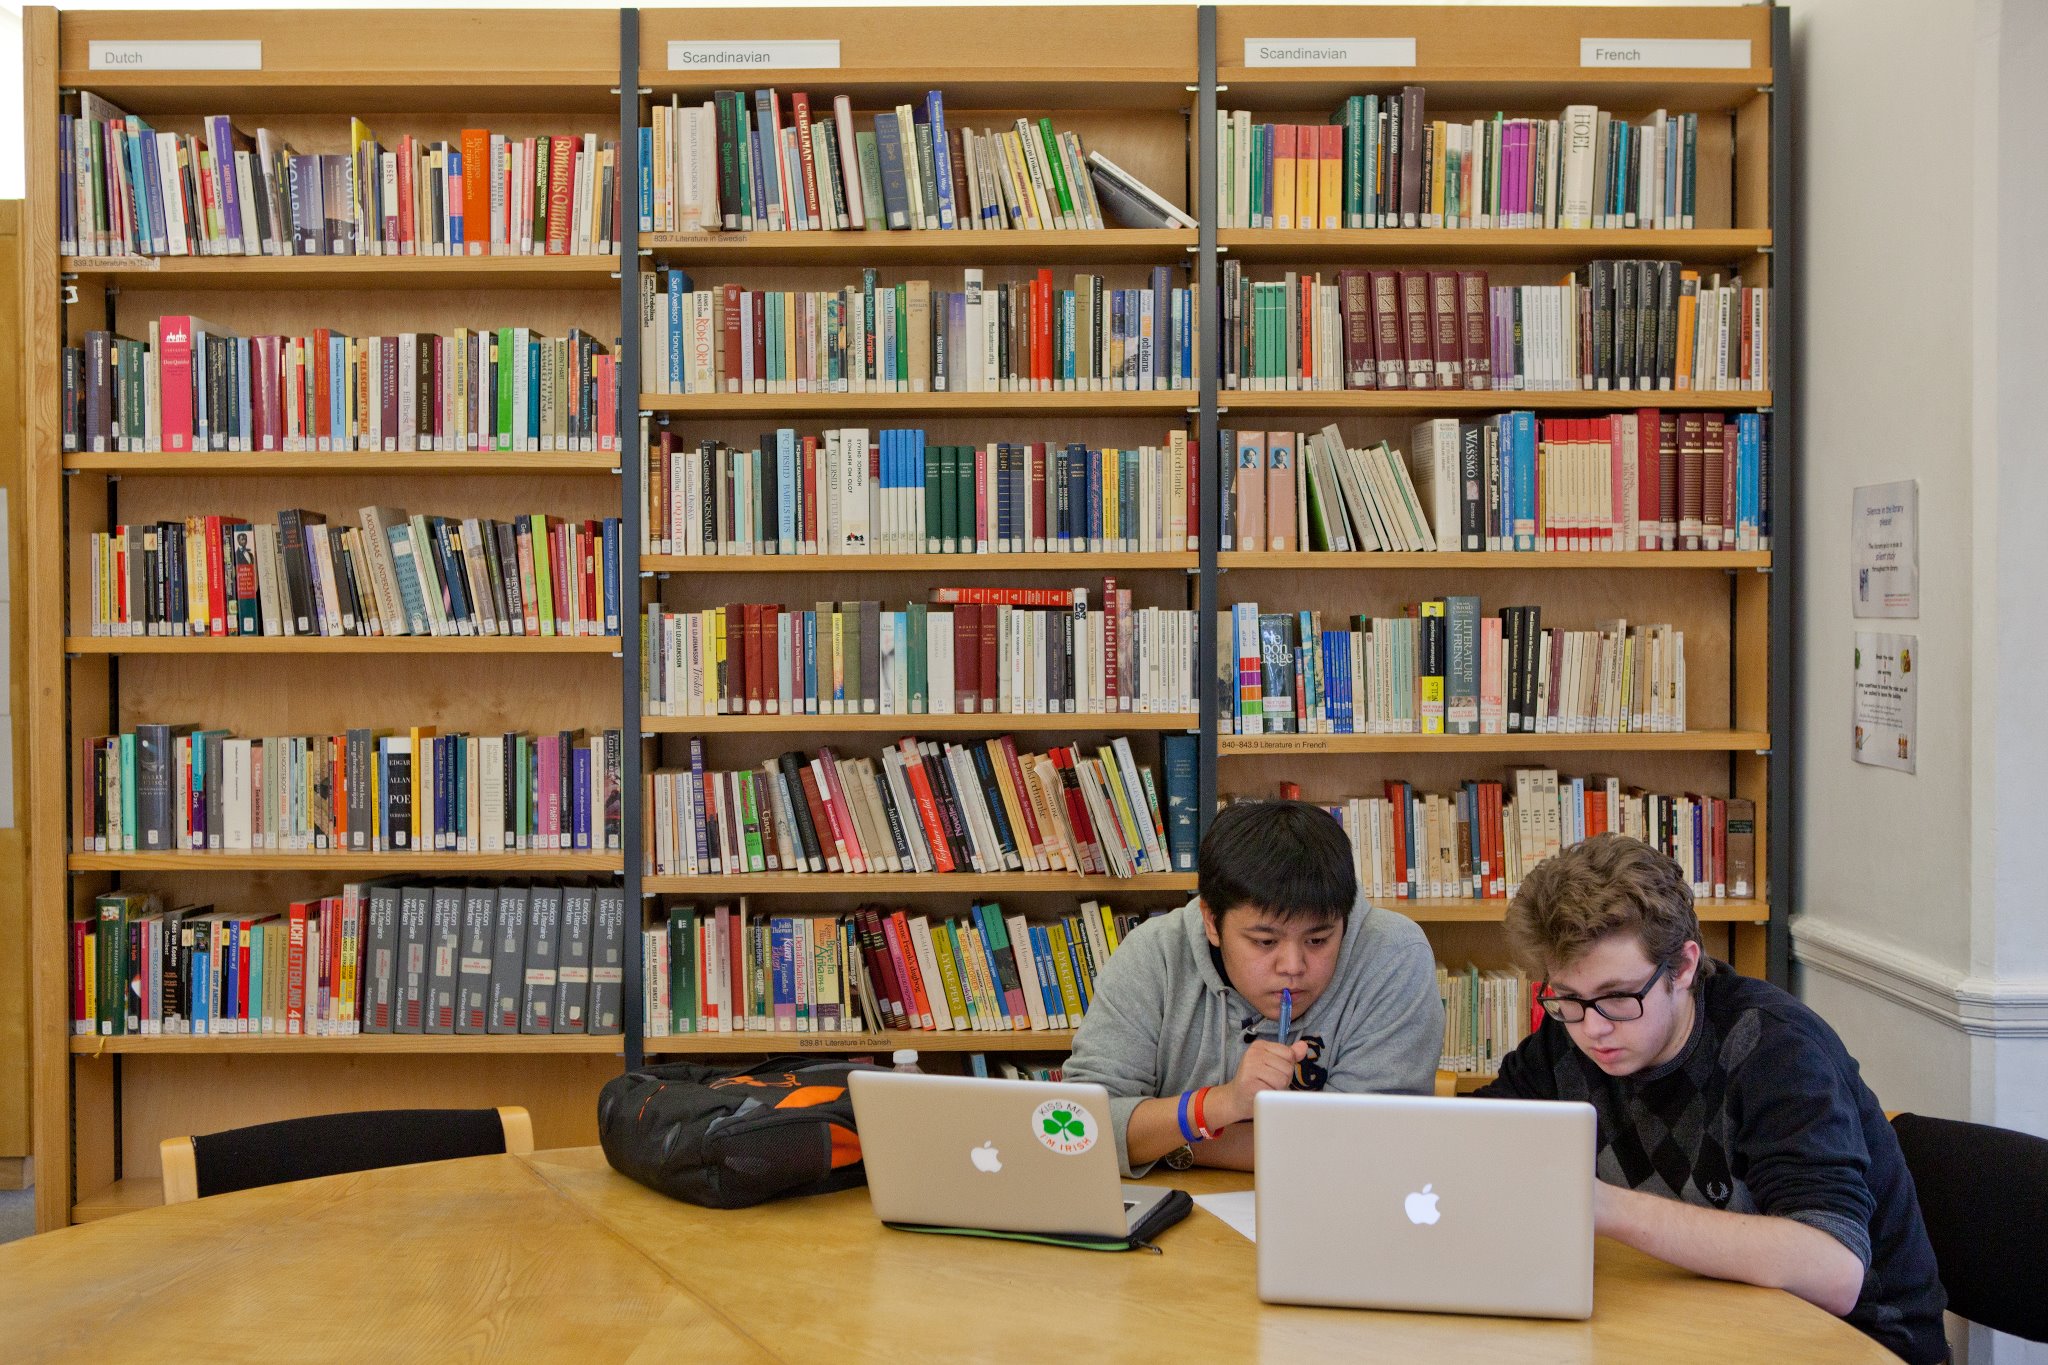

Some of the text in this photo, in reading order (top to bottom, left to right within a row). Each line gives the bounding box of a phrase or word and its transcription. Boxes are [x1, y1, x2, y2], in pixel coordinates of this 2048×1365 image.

[104, 50, 143, 65] Dutch
[682, 50, 770, 64] Scandinavian
[1259, 47, 1347, 61] Scandinavian
[1595, 48, 1640, 62] French
[1020, 121, 1033, 148] Perspektiv
[1571, 114, 1590, 154] HOEL
[473, 138, 482, 178] Belcampo
[723, 142, 734, 174] Språket
[921, 126, 932, 177] Harry Martinson
[552, 140, 572, 192] Bomans
[95, 259, 127, 267] Literature
[672, 278, 680, 324] Sun Axelsson
[865, 275, 876, 364] Sven Delblanc Åminne
[695, 318, 710, 366] RÖDE ORM
[1141, 337, 1150, 373] och ekarna
[782, 434, 791, 444] PC
[782, 445, 791, 479] JERSILD
[1465, 429, 1477, 478] WASSMO
[830, 449, 838, 490] PC JERSILD
[847, 467, 853, 476] OM
[673, 456, 683, 516] Jan Guillou COQ
[703, 446, 712, 541] Lars Gustafsson SIGISMUND
[783, 484, 792, 514] BABELS
[510, 577, 521, 613] REVOLUTIE
[1263, 643, 1288, 654] bon
[1453, 620, 1462, 675] IN FRENCH
[1463, 619, 1472, 683] LITERATURE
[389, 794, 411, 805] POE
[887, 807, 905, 851] Juloratoriet
[369, 898, 378, 925] Werken
[385, 899, 393, 925] Lexicon
[401, 898, 410, 925] Werken
[417, 899, 426, 926] Lexicon
[466, 899, 474, 926] Werken
[482, 899, 491, 926] Lexicon
[532, 899, 541, 925] Werken
[548, 899, 556, 925] Lexicon
[599, 899, 607, 926] Werken
[615, 899, 624, 925] Lexicon
[231, 925, 238, 934] Op
[376, 912, 385, 939] Literaire
[408, 912, 417, 939] Literaire
[473, 912, 482, 939] Literaire
[539, 912, 547, 939] Literaire
[606, 912, 615, 939] Literaire
[289, 918, 303, 1018] LICHT LETTERLAND 4
[826, 940, 835, 975] Breve fra
[897, 919, 922, 993] Anne Frank's dagbog
[957, 934, 978, 991] SÆRE HISTORIER
[973, 934, 995, 991] SÆRE HISTORIER
[796, 936, 805, 1011] Den afrikanske Farm
[941, 953, 961, 1011] LYKKE-PER 2
[1039, 1102, 1084, 1116] KISS ME
[1060, 1137, 1092, 1152] IRISH
